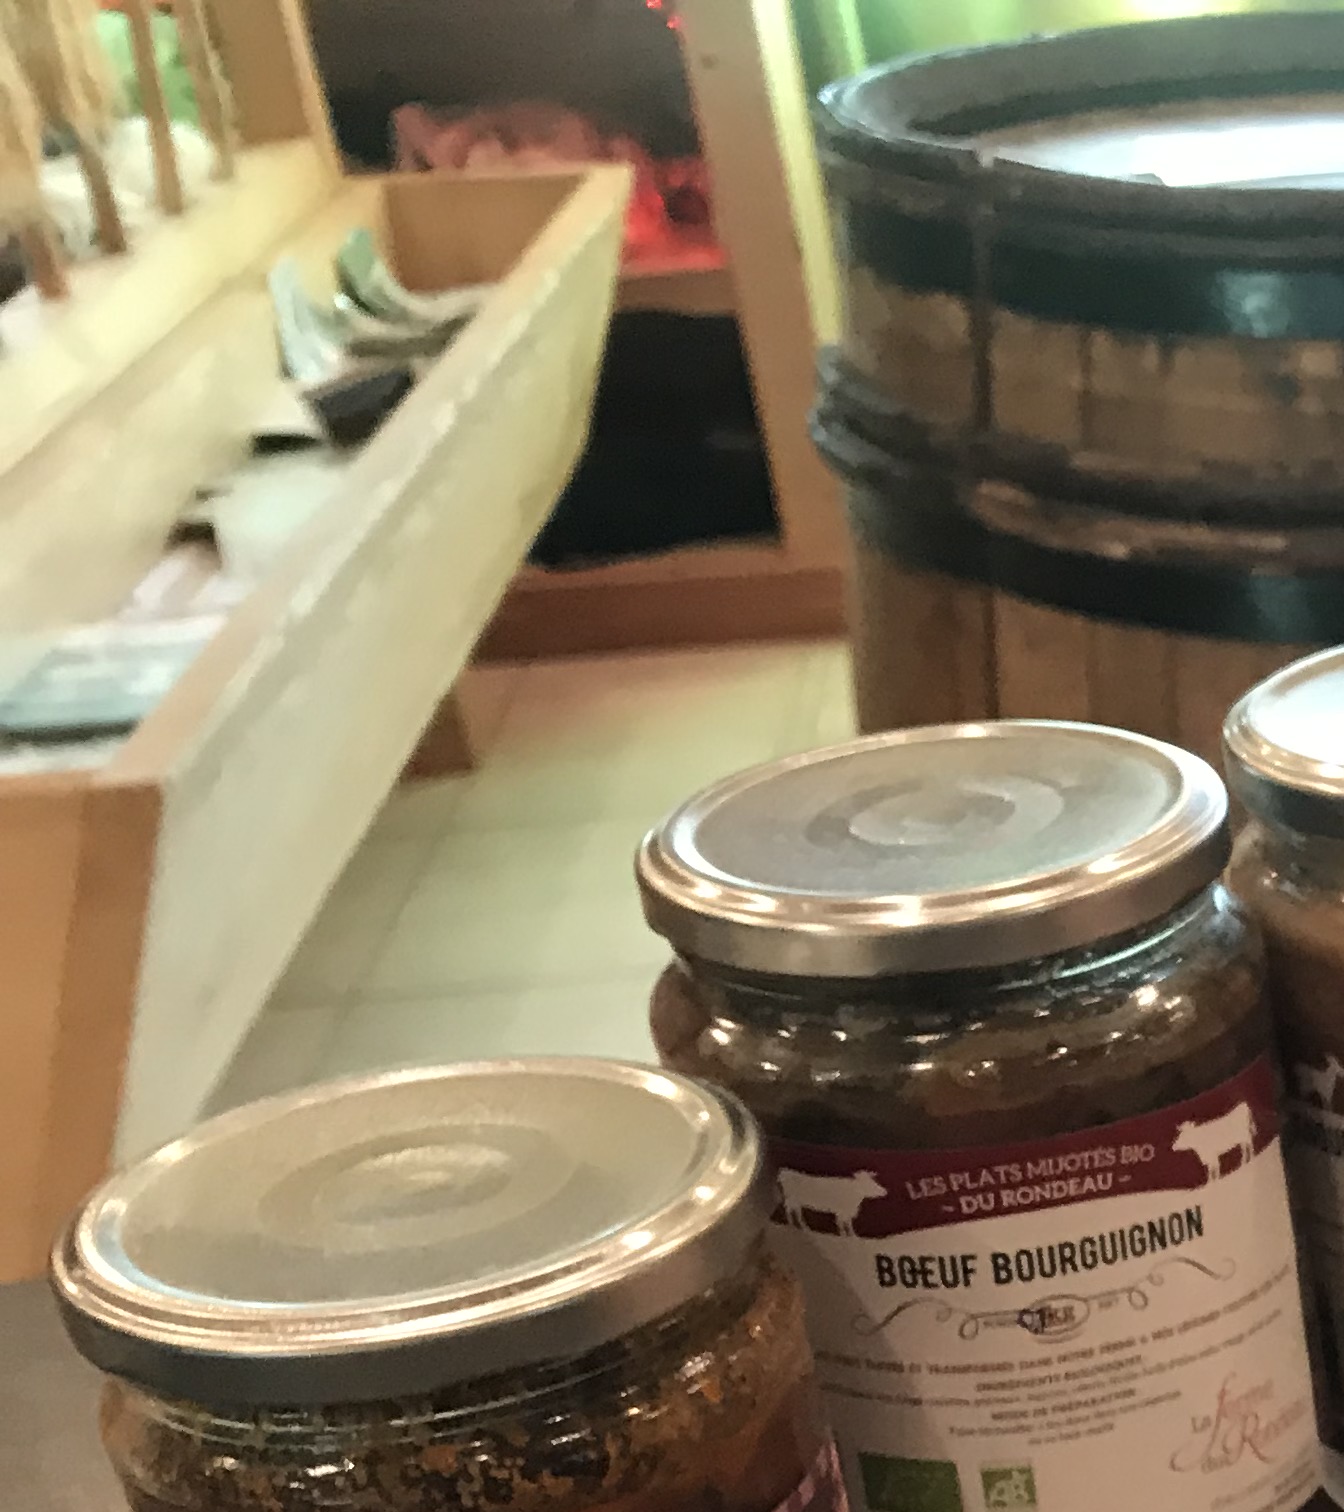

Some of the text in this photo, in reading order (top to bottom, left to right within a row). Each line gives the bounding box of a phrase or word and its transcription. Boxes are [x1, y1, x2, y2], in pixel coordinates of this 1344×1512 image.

[905, 1175, 947, 1200] LES
[949, 1164, 1023, 1192] PLATS
[959, 1172, 1113, 1214] DU RONDEAU
[990, 1205, 1205, 1285] BOURGUIGNON
